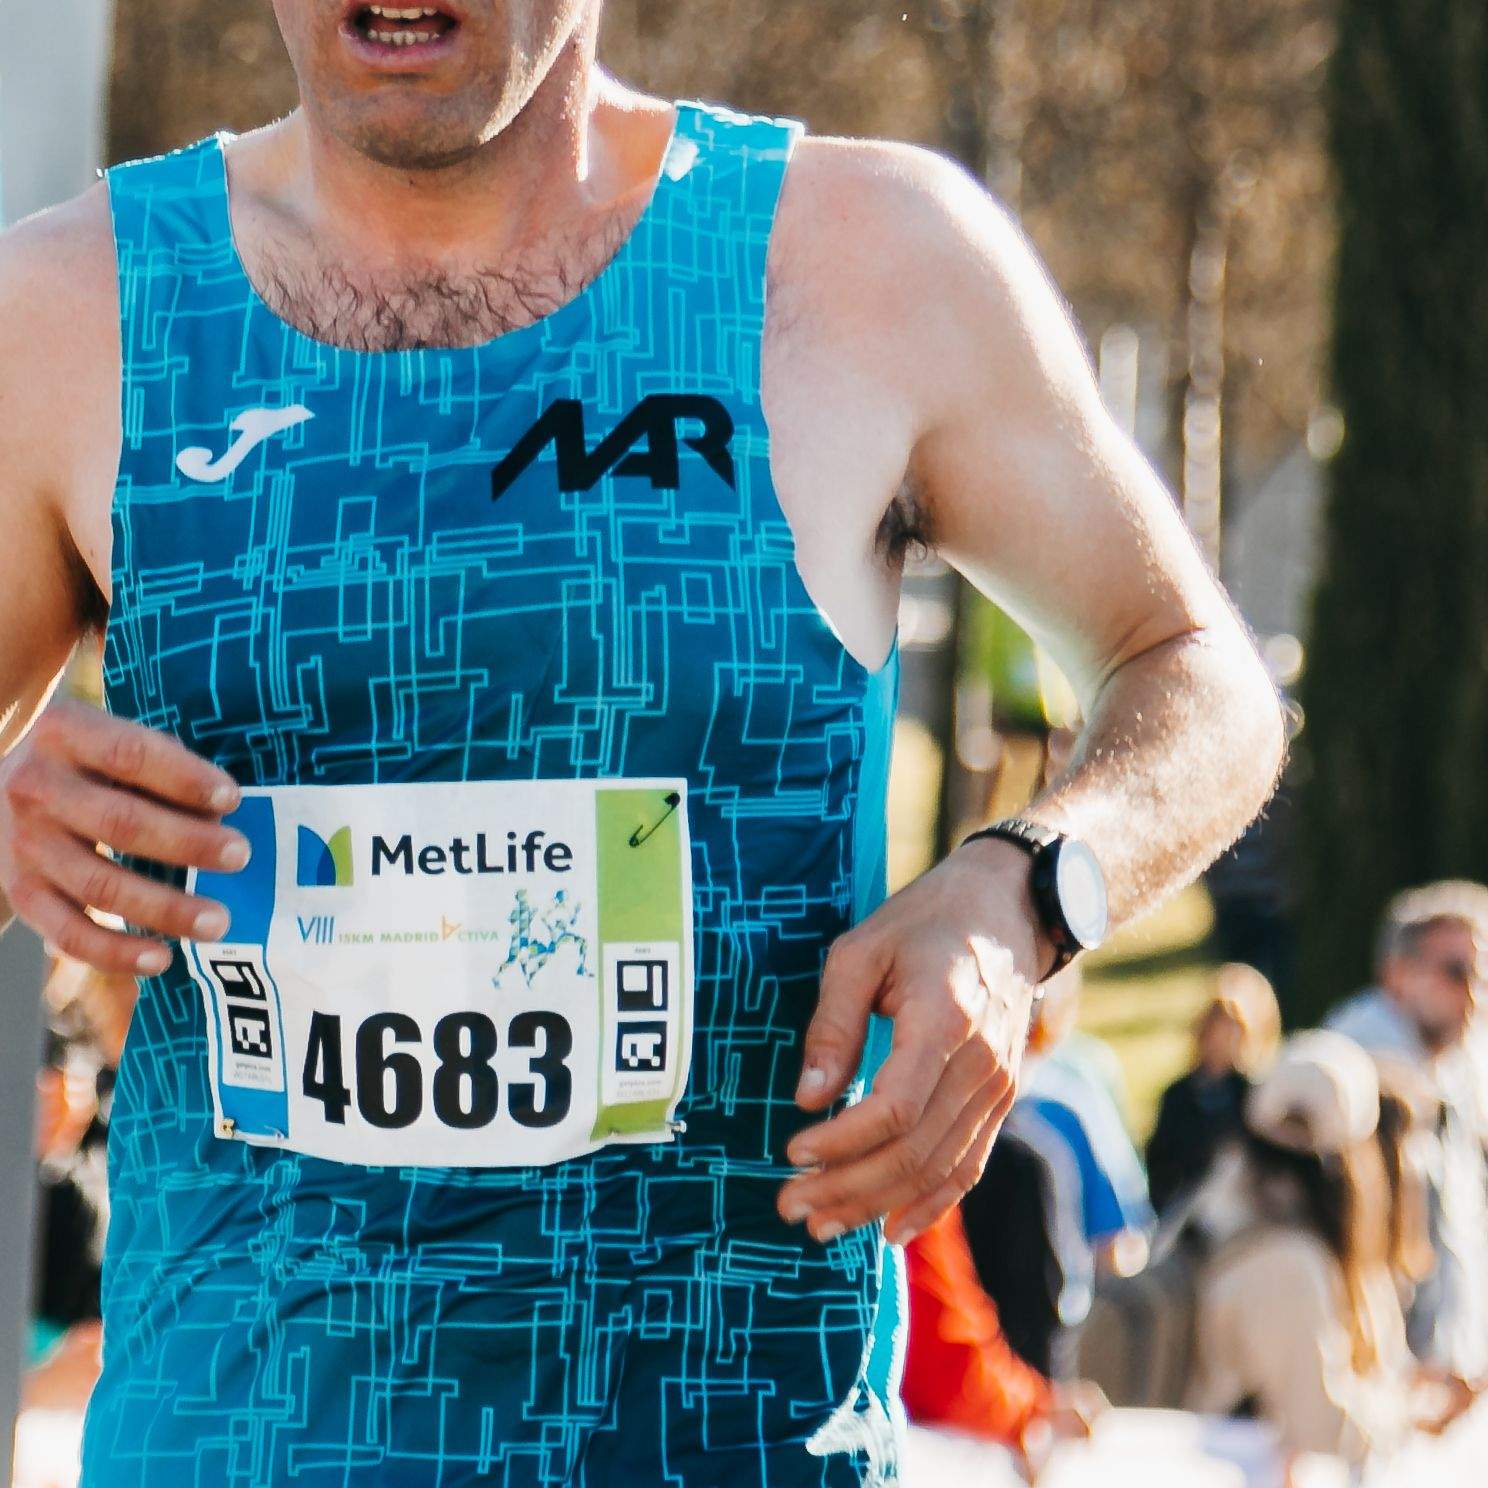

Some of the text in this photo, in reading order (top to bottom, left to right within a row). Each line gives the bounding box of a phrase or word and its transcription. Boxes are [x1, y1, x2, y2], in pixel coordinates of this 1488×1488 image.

[371, 830, 573, 877] MetLife
[297, 915, 335, 945] VIII
[379, 930, 440, 943] MADRID
[302, 1010, 573, 1130] 4683
